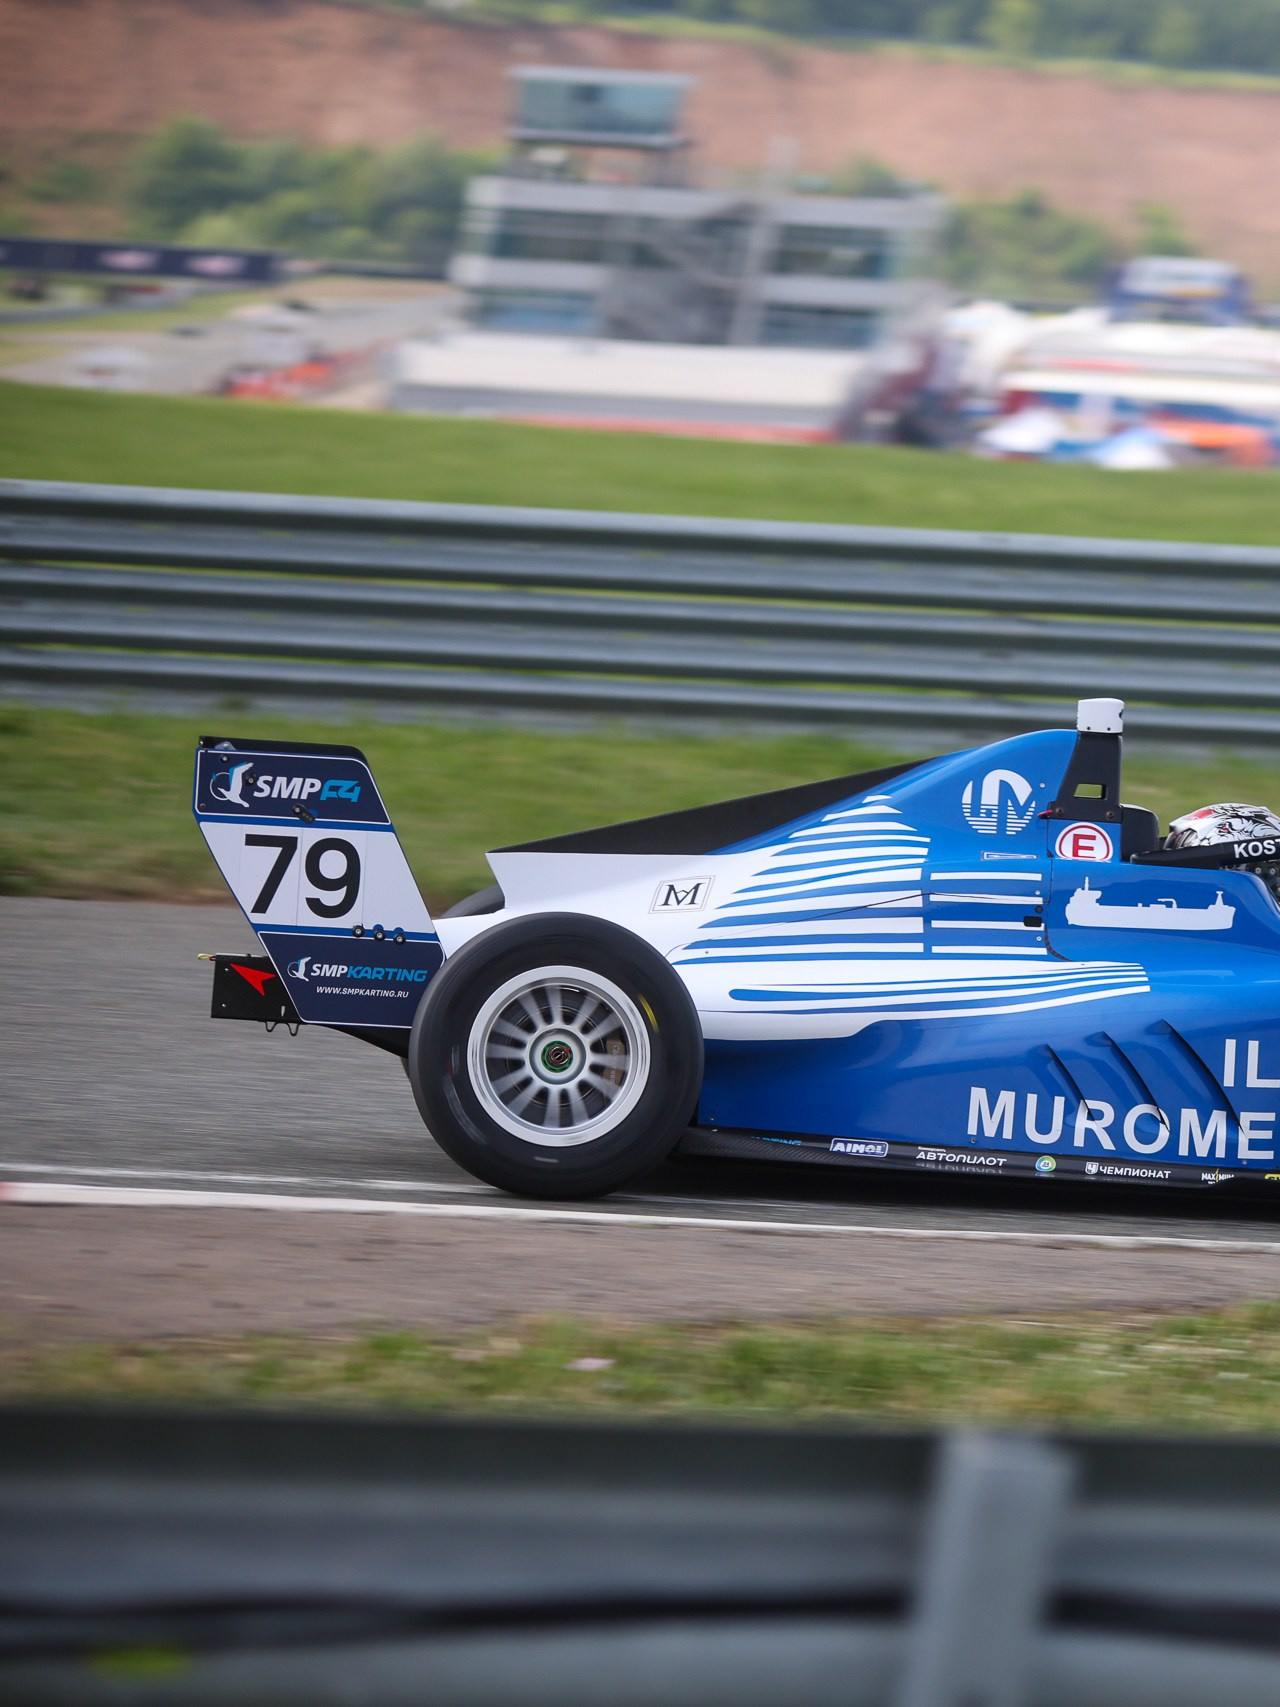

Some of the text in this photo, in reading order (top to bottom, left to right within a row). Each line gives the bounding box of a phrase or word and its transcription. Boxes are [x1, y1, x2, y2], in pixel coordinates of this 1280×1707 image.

[1072, 834, 1096, 859] E
[244, 833, 361, 918] 79
[657, 882, 706, 906] M
[311, 963, 428, 982] SMPKARTING
[316, 986, 409, 998] WWW.SMPKARTING.RU
[916, 1151, 1007, 1167] АВТОПИЛОТ
[1099, 1165, 1171, 1179] ЧЕМПИОНАТ
